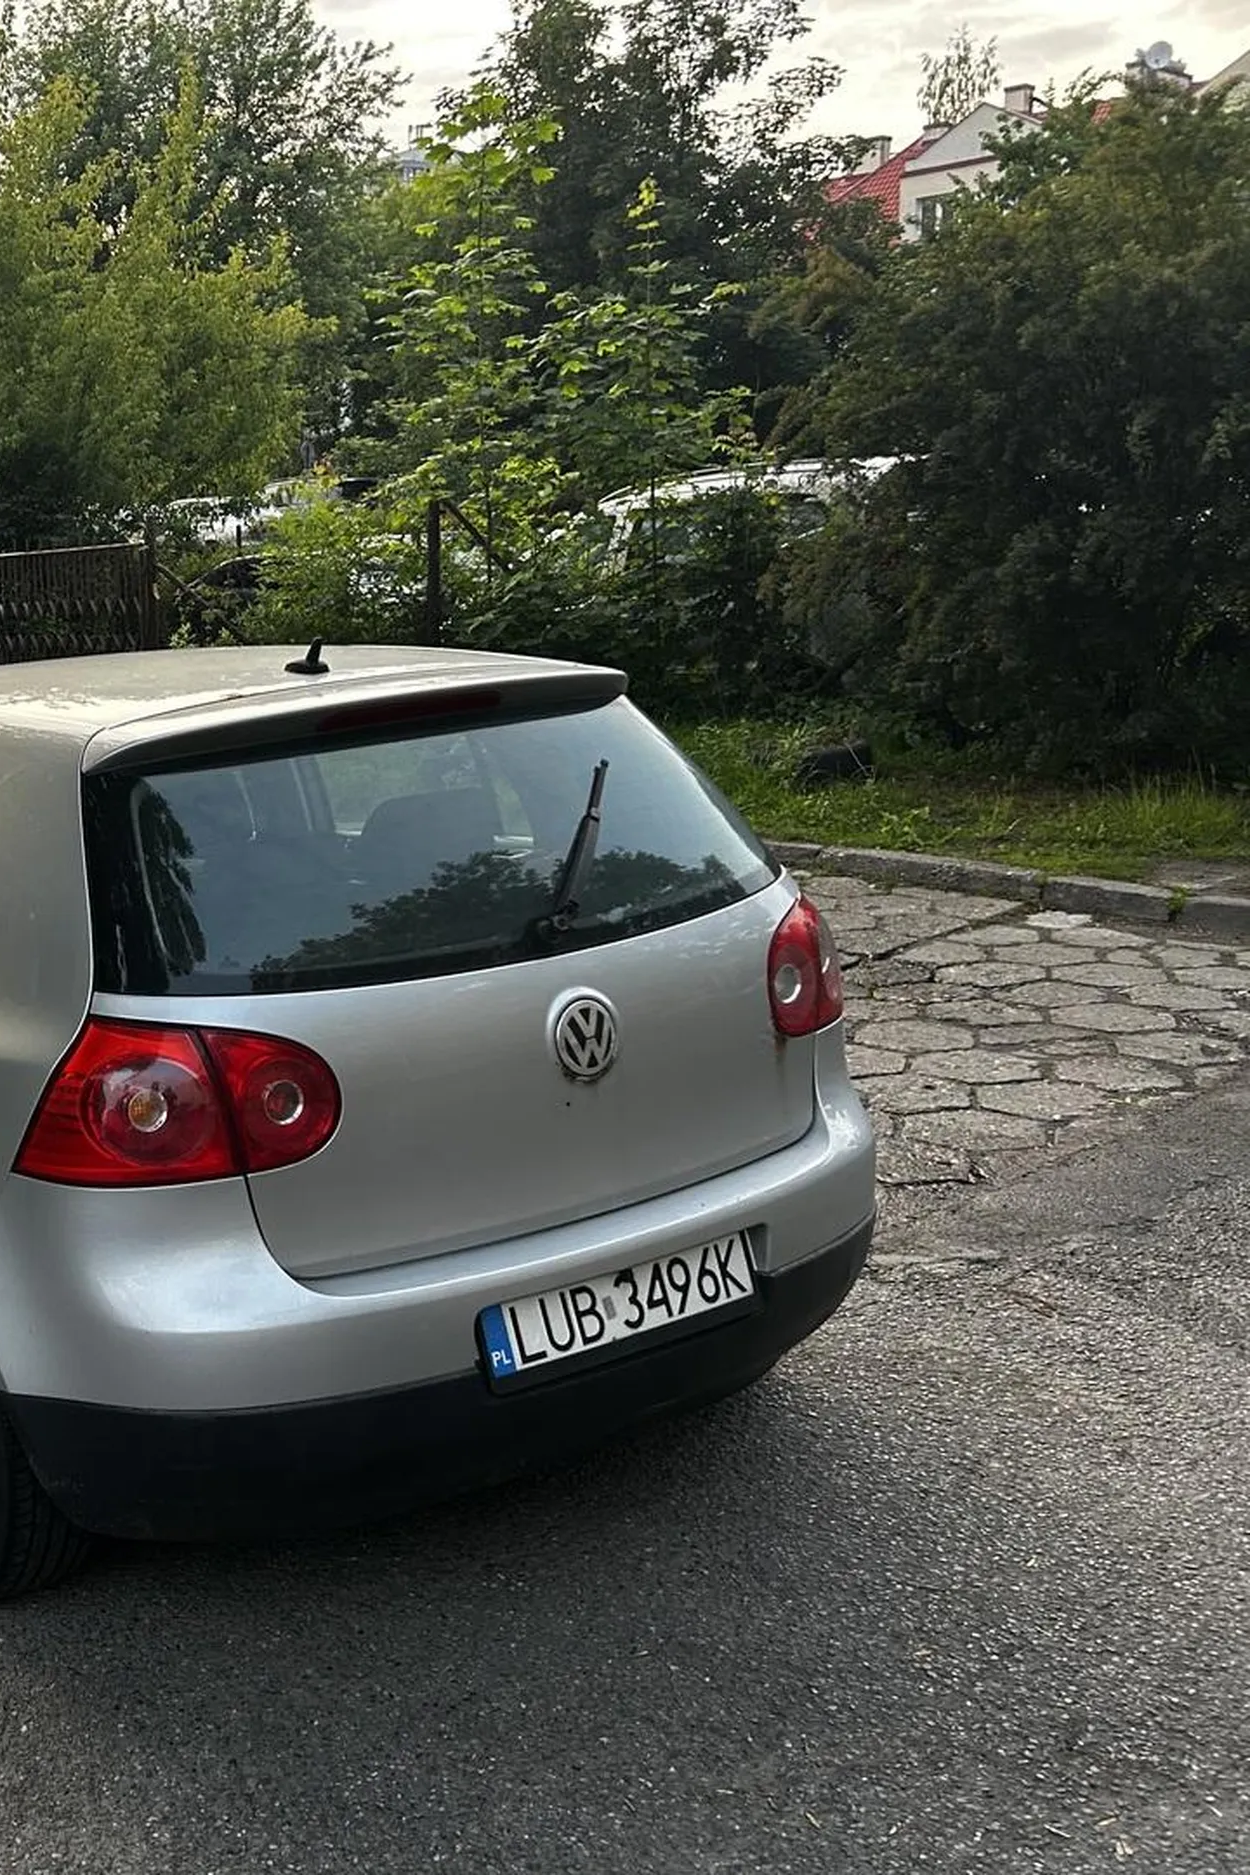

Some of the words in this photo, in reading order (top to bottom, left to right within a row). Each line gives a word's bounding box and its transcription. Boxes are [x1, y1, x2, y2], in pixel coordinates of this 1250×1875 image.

[559, 1001, 613, 1073] VW
[509, 1284, 606, 1365] LUB
[613, 1238, 747, 1329] 3496K
[490, 1350, 511, 1368] PL
